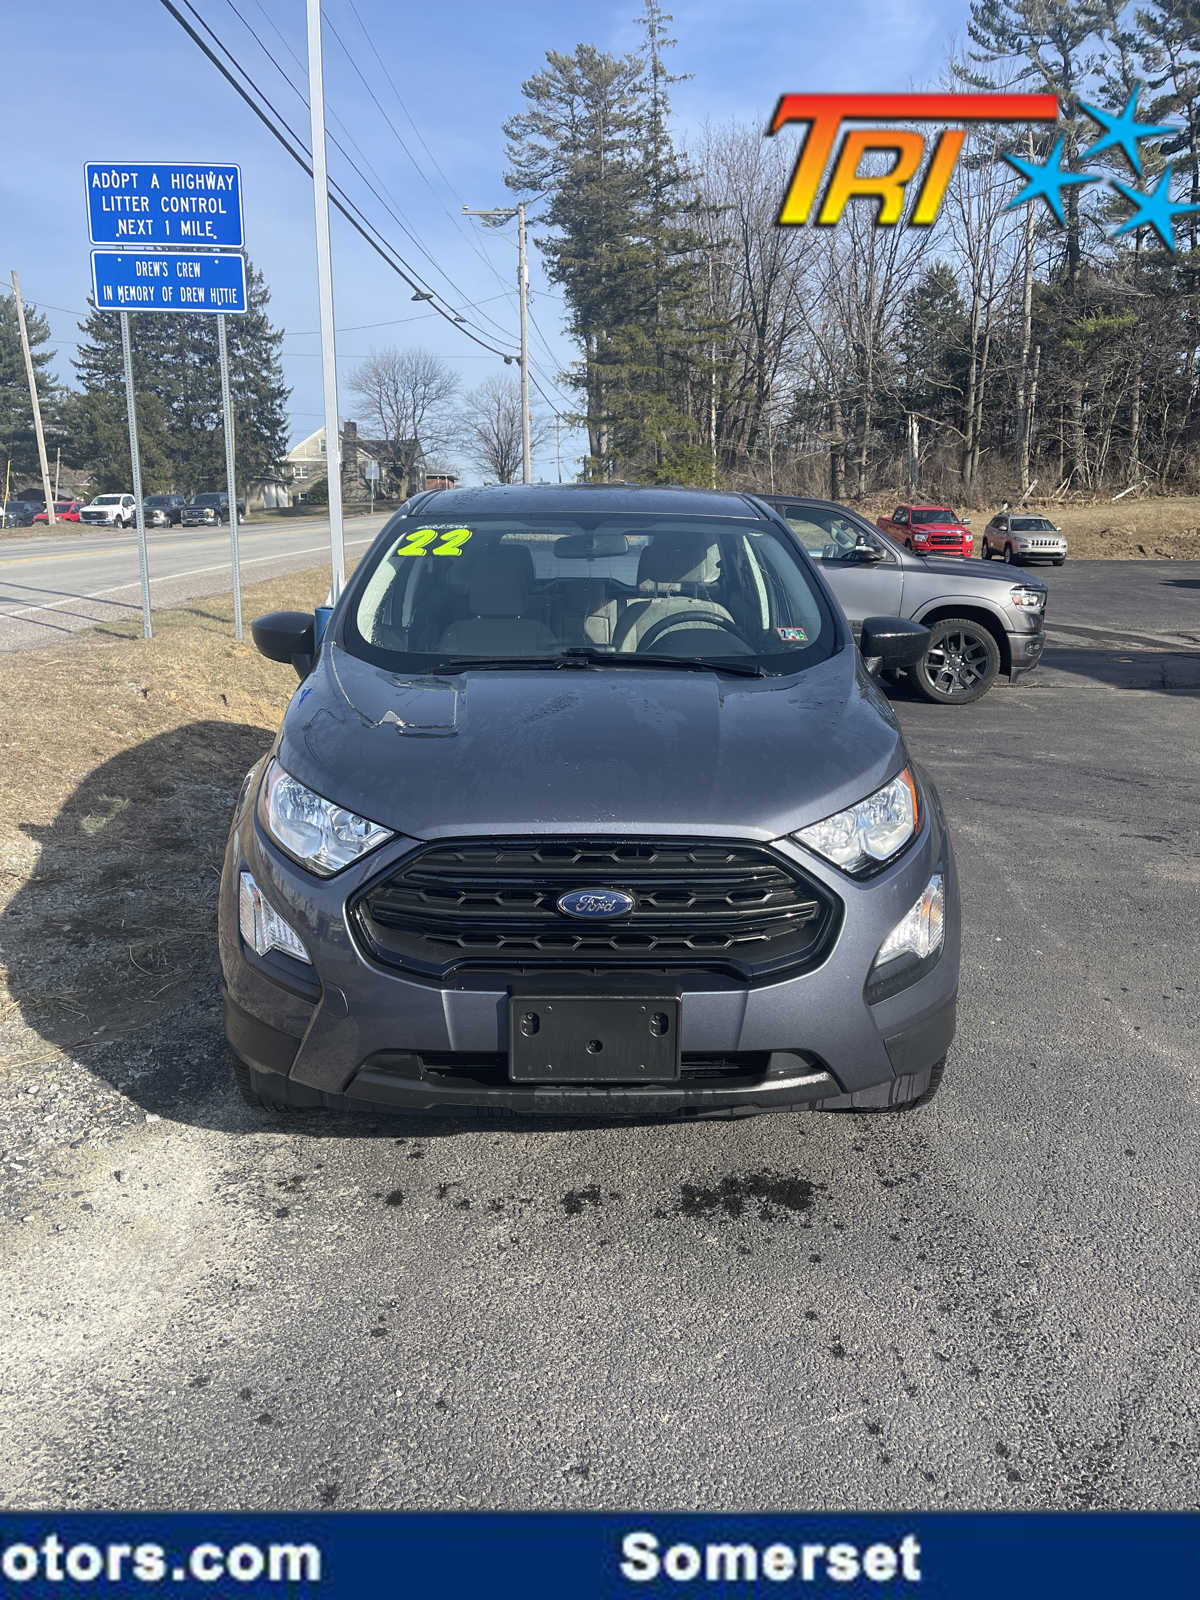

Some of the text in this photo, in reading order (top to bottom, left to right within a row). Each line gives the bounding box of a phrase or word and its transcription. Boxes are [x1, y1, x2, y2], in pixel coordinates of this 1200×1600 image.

[92, 172, 234, 191] ADOPT A HIGHWAY
[101, 195, 227, 214] LITTER CONTROL
[118, 219, 214, 237] NEXT 1 MILE
[135, 261, 201, 278] DREW'S CREW
[103, 285, 113, 301] IN
[118, 285, 154, 302] MEMORY
[162, 286, 173, 302] OF
[180, 287, 205, 303] DREW
[397, 528, 473, 557] 22
[576, 894, 617, 912] Ford
